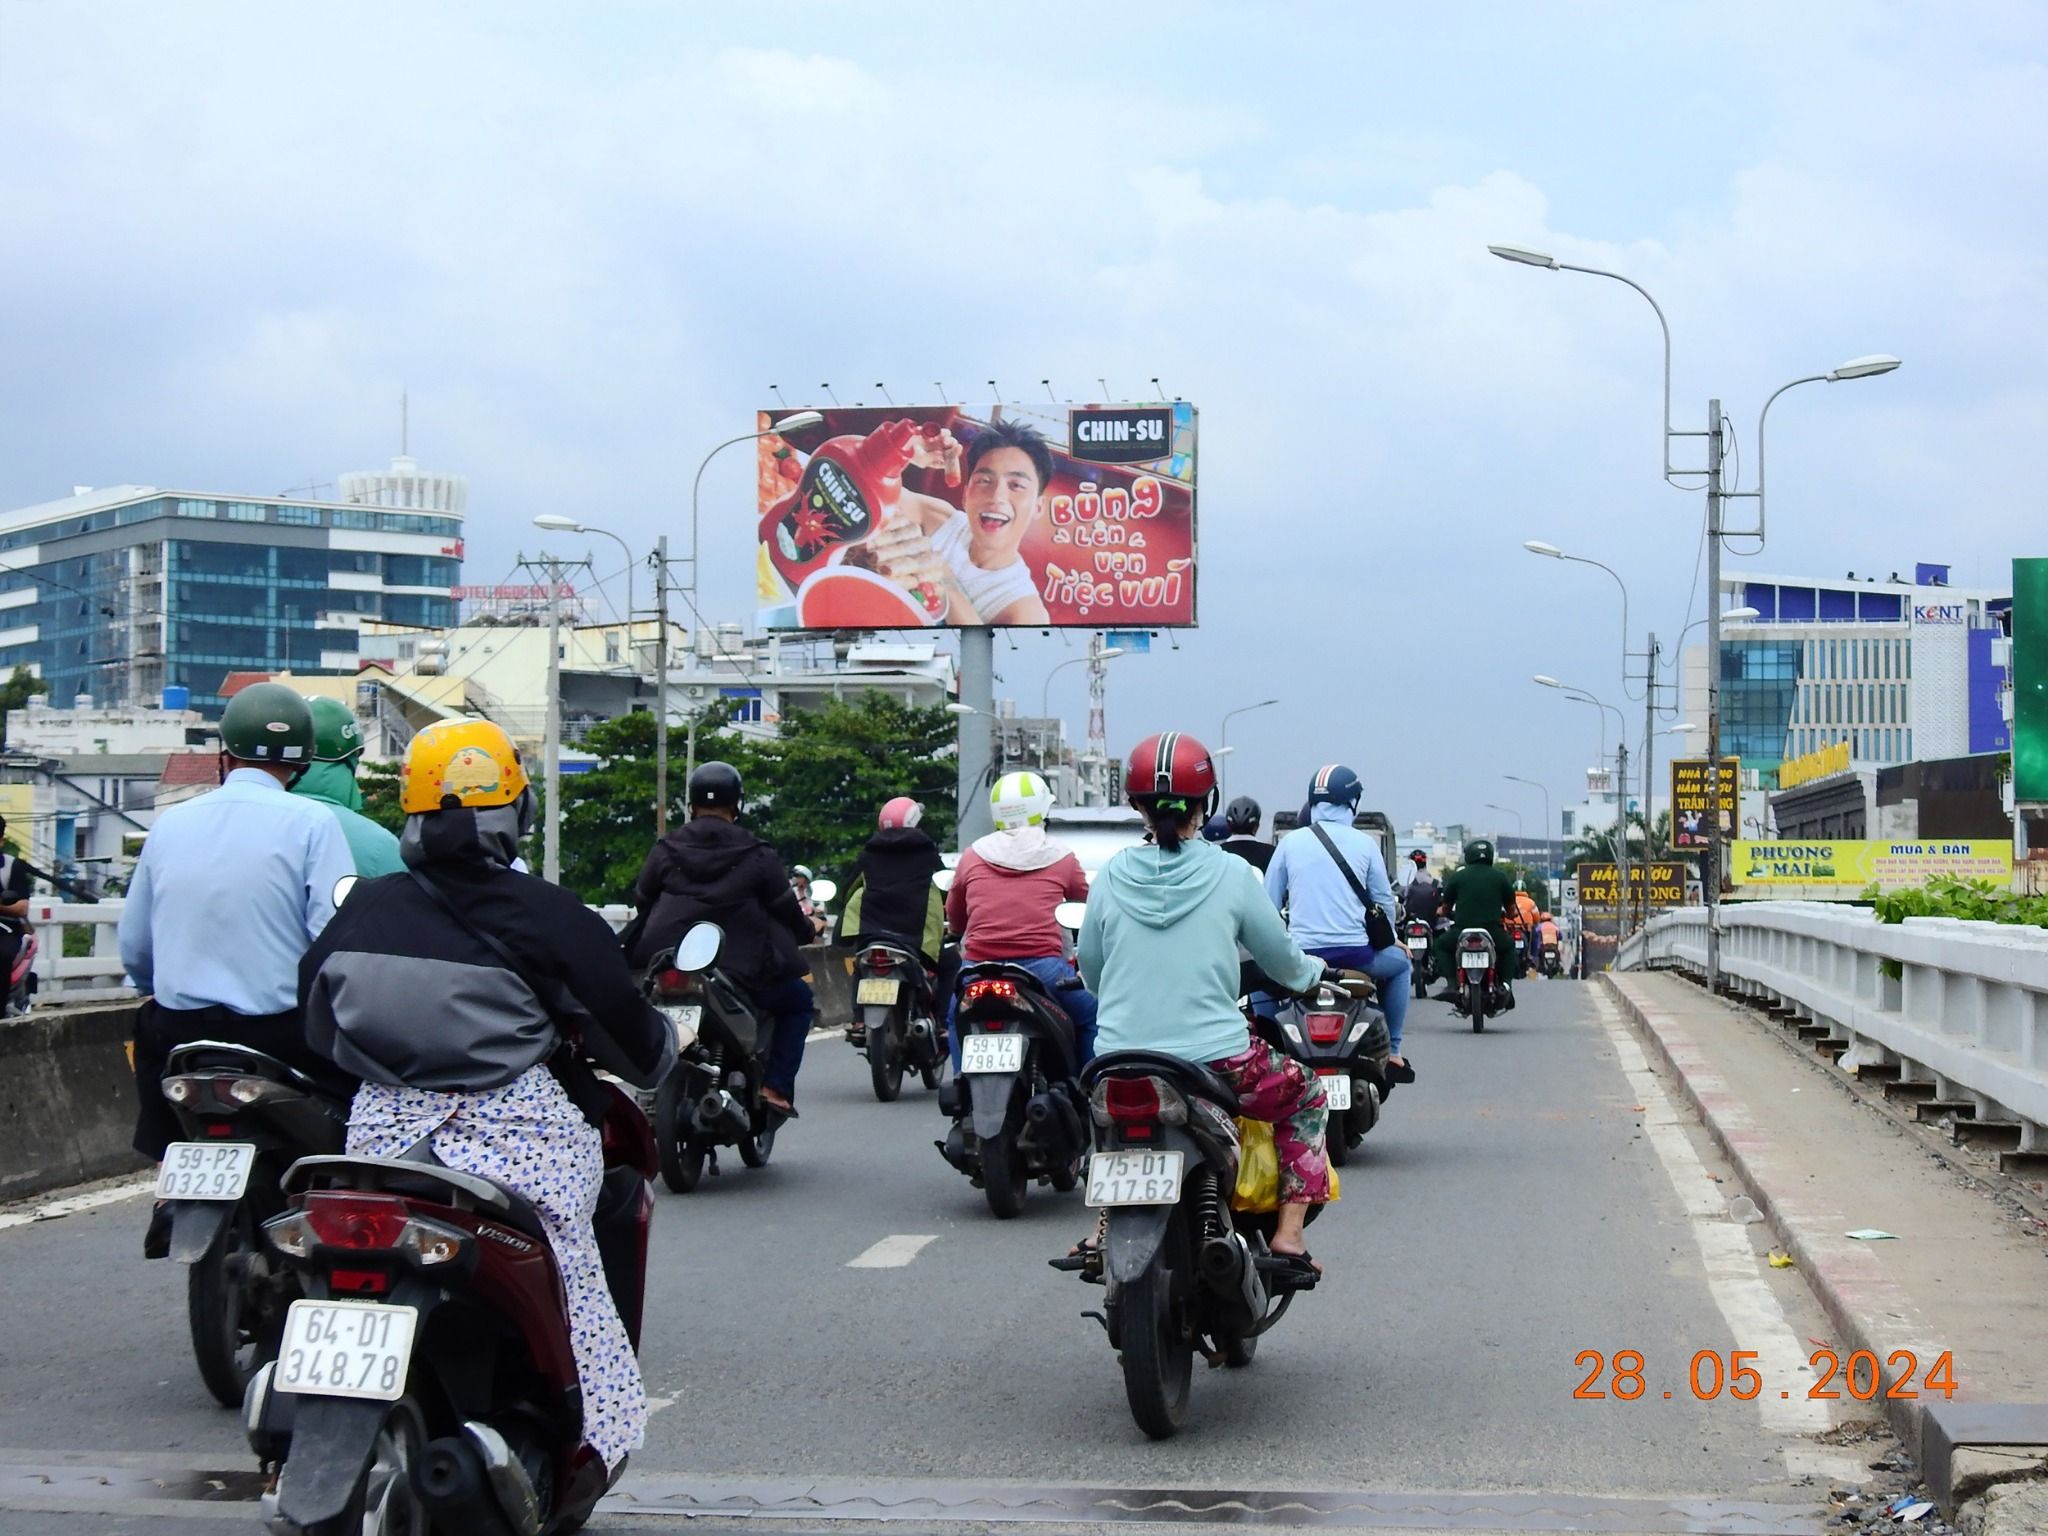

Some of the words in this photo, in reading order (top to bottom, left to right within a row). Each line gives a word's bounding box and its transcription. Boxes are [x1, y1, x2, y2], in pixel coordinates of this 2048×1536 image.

[1077, 419, 1163, 442] CHIN-SU
[818, 462, 866, 523] CHIN-SU
[1890, 845, 1923, 855] MUA
[1927, 845, 1937, 855] &
[1773, 862, 1811, 877] MAI
[177, 1148, 240, 1171] 59-P2
[1105, 1154, 1166, 1177] 75-D1
[163, 1172, 242, 1196] 032.92
[1092, 1179, 1175, 1203] 217.62
[305, 1308, 392, 1349] 64-D1
[285, 1348, 399, 1392] 348.78
